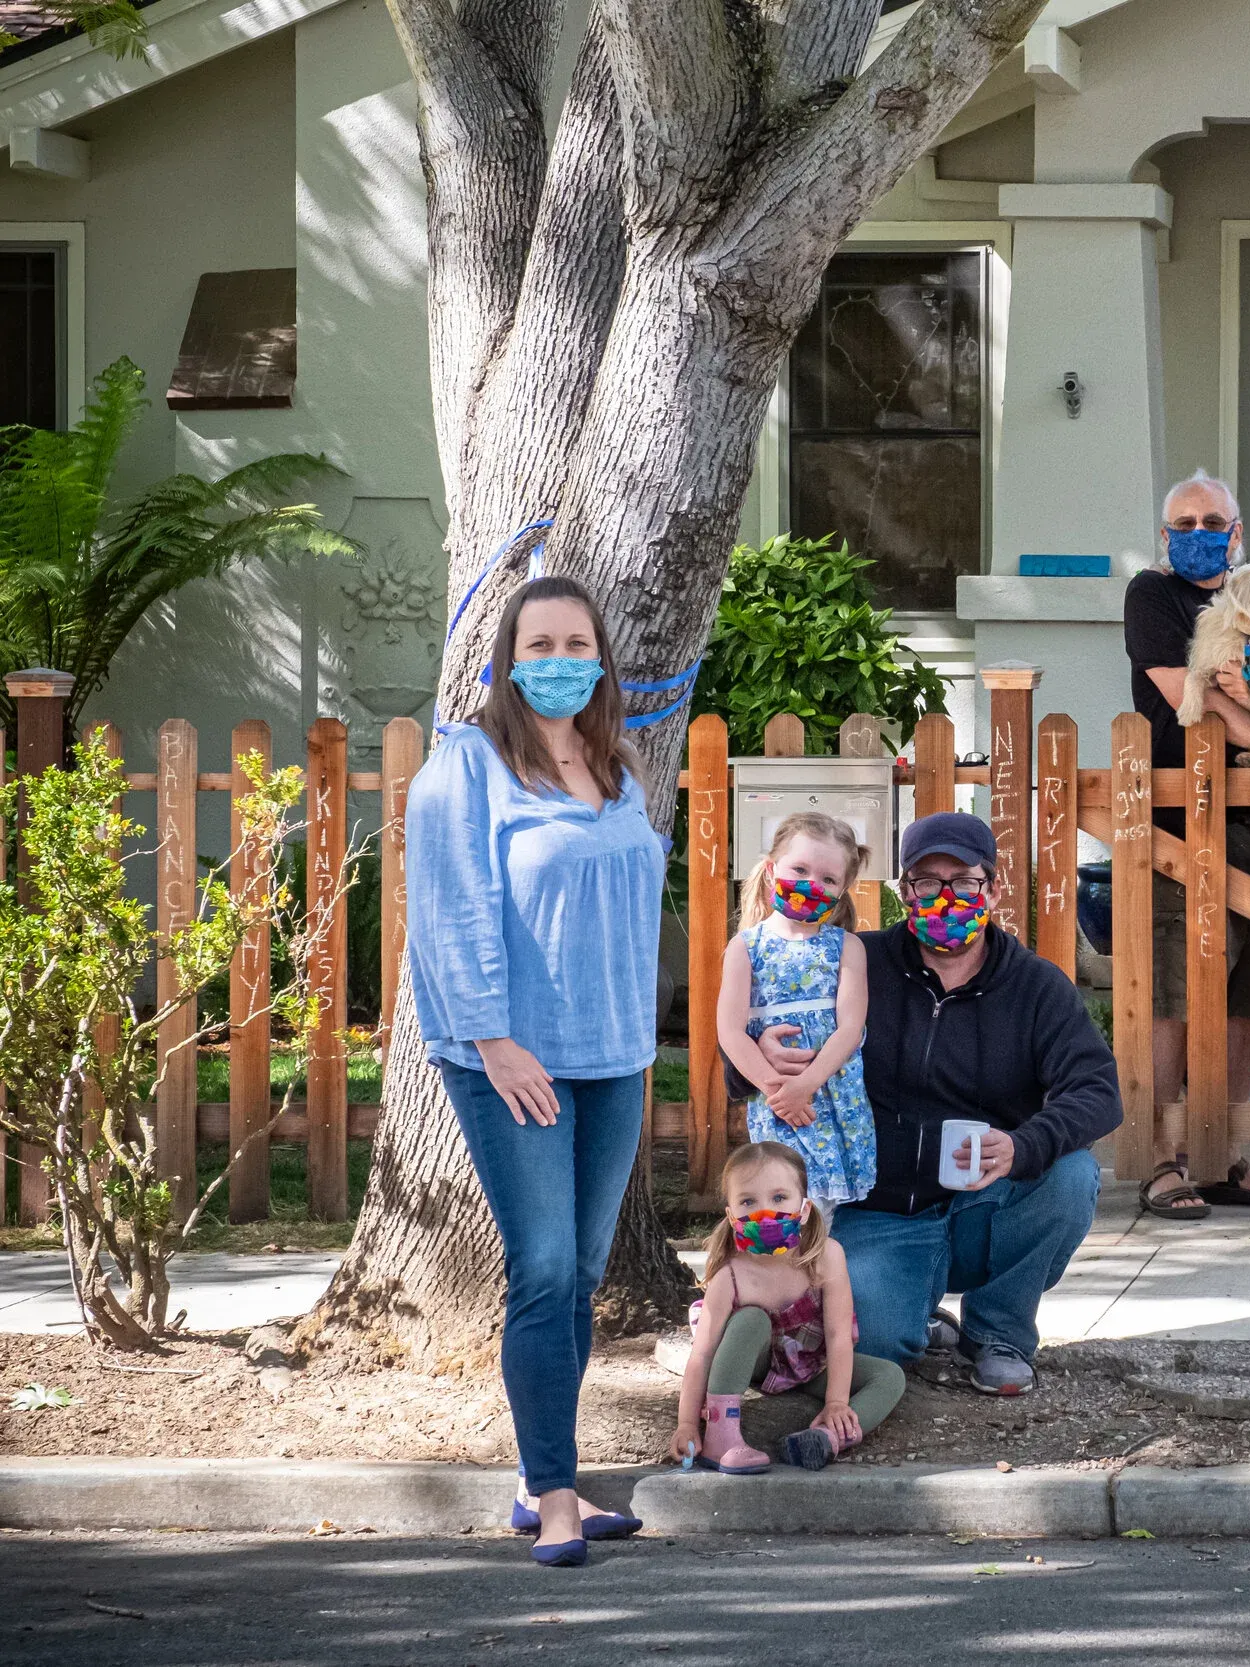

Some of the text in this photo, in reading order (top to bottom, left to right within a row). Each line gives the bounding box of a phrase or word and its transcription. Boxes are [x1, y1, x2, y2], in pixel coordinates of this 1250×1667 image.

[160, 732, 190, 940] BALANCE
[314, 786, 333, 1012] KINDNESS
[695, 788, 727, 877] JOY
[1193, 731, 1218, 958] SELF CARE
